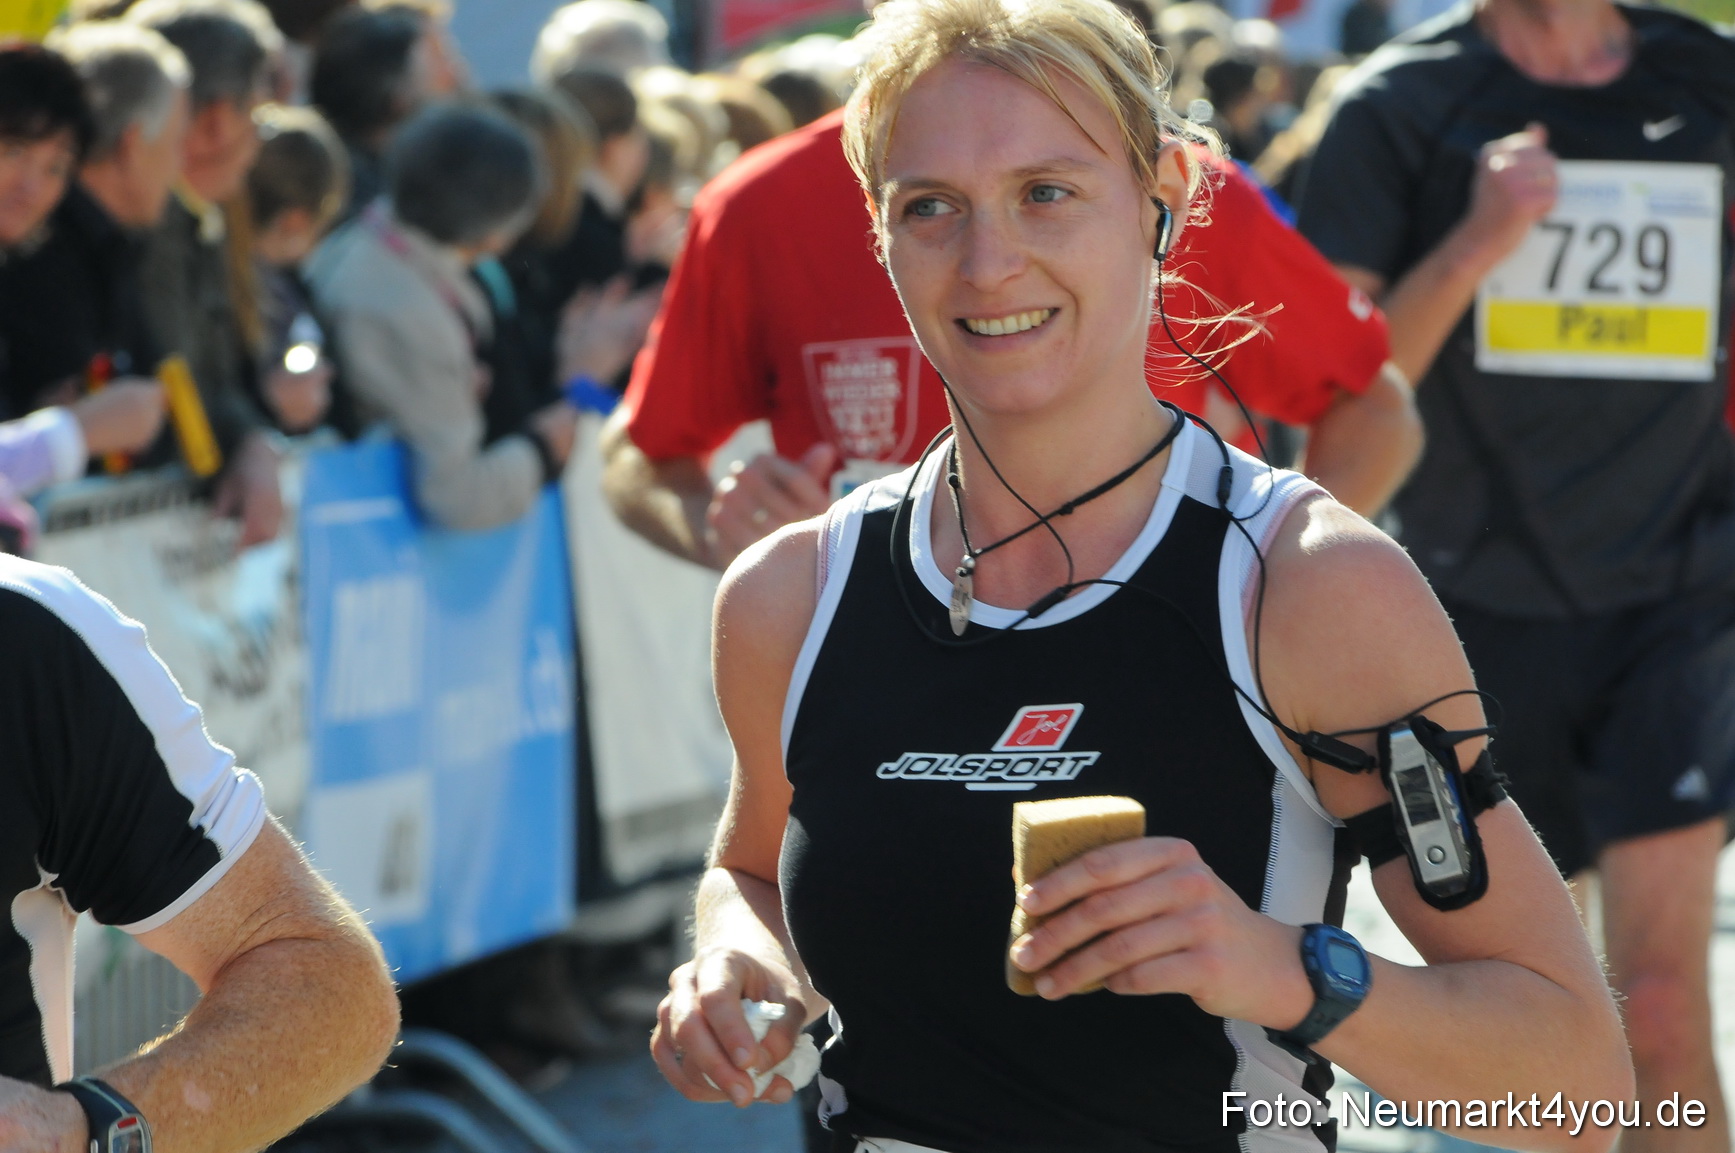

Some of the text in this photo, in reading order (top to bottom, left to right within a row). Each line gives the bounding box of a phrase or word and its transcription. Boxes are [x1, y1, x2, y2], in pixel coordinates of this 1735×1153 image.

[1538, 221, 1672, 297] 729
[1558, 303, 1649, 345] Paul
[877, 753, 1099, 780] JOLSPORT
